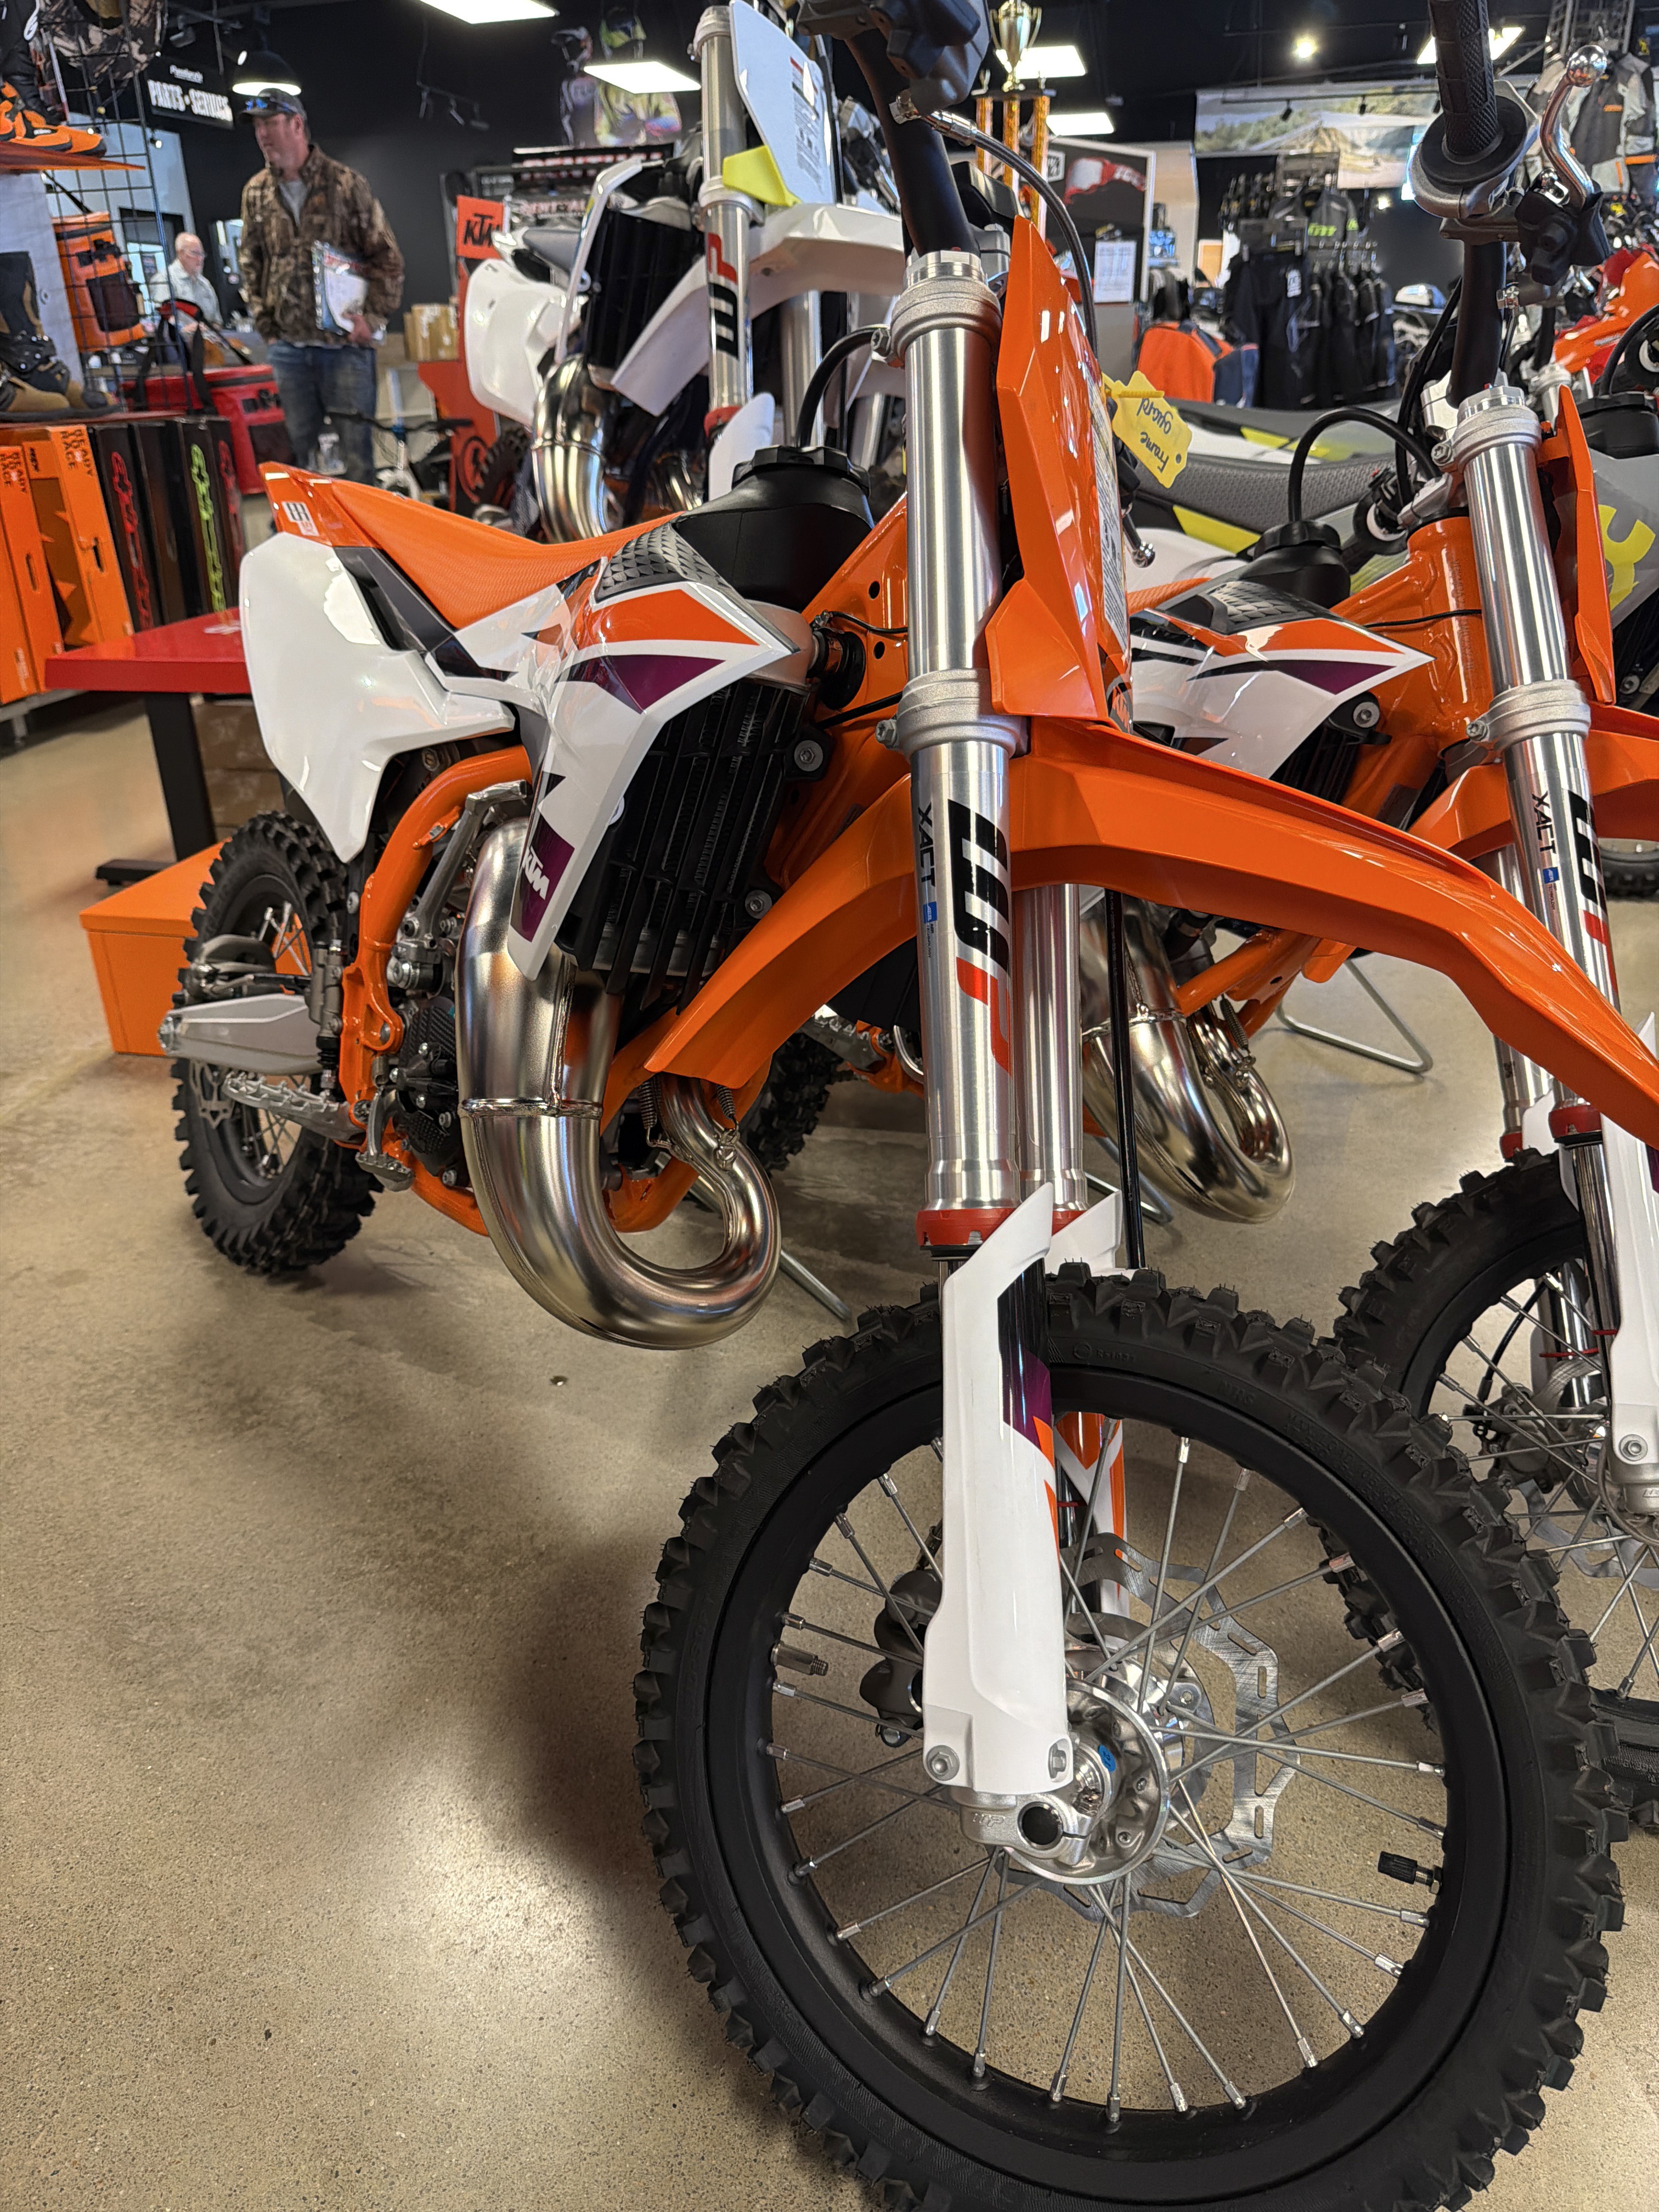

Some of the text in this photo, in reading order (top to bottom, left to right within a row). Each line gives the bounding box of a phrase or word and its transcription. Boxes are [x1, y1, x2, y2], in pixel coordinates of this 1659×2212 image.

[148, 80, 185, 111] PARTS
[1136, 398, 1173, 435] guard
[1140, 431, 1169, 473] Frame
[918, 802, 936, 888] XACT
[1531, 790, 1556, 855] XACT
[522, 846, 550, 901] KTM
